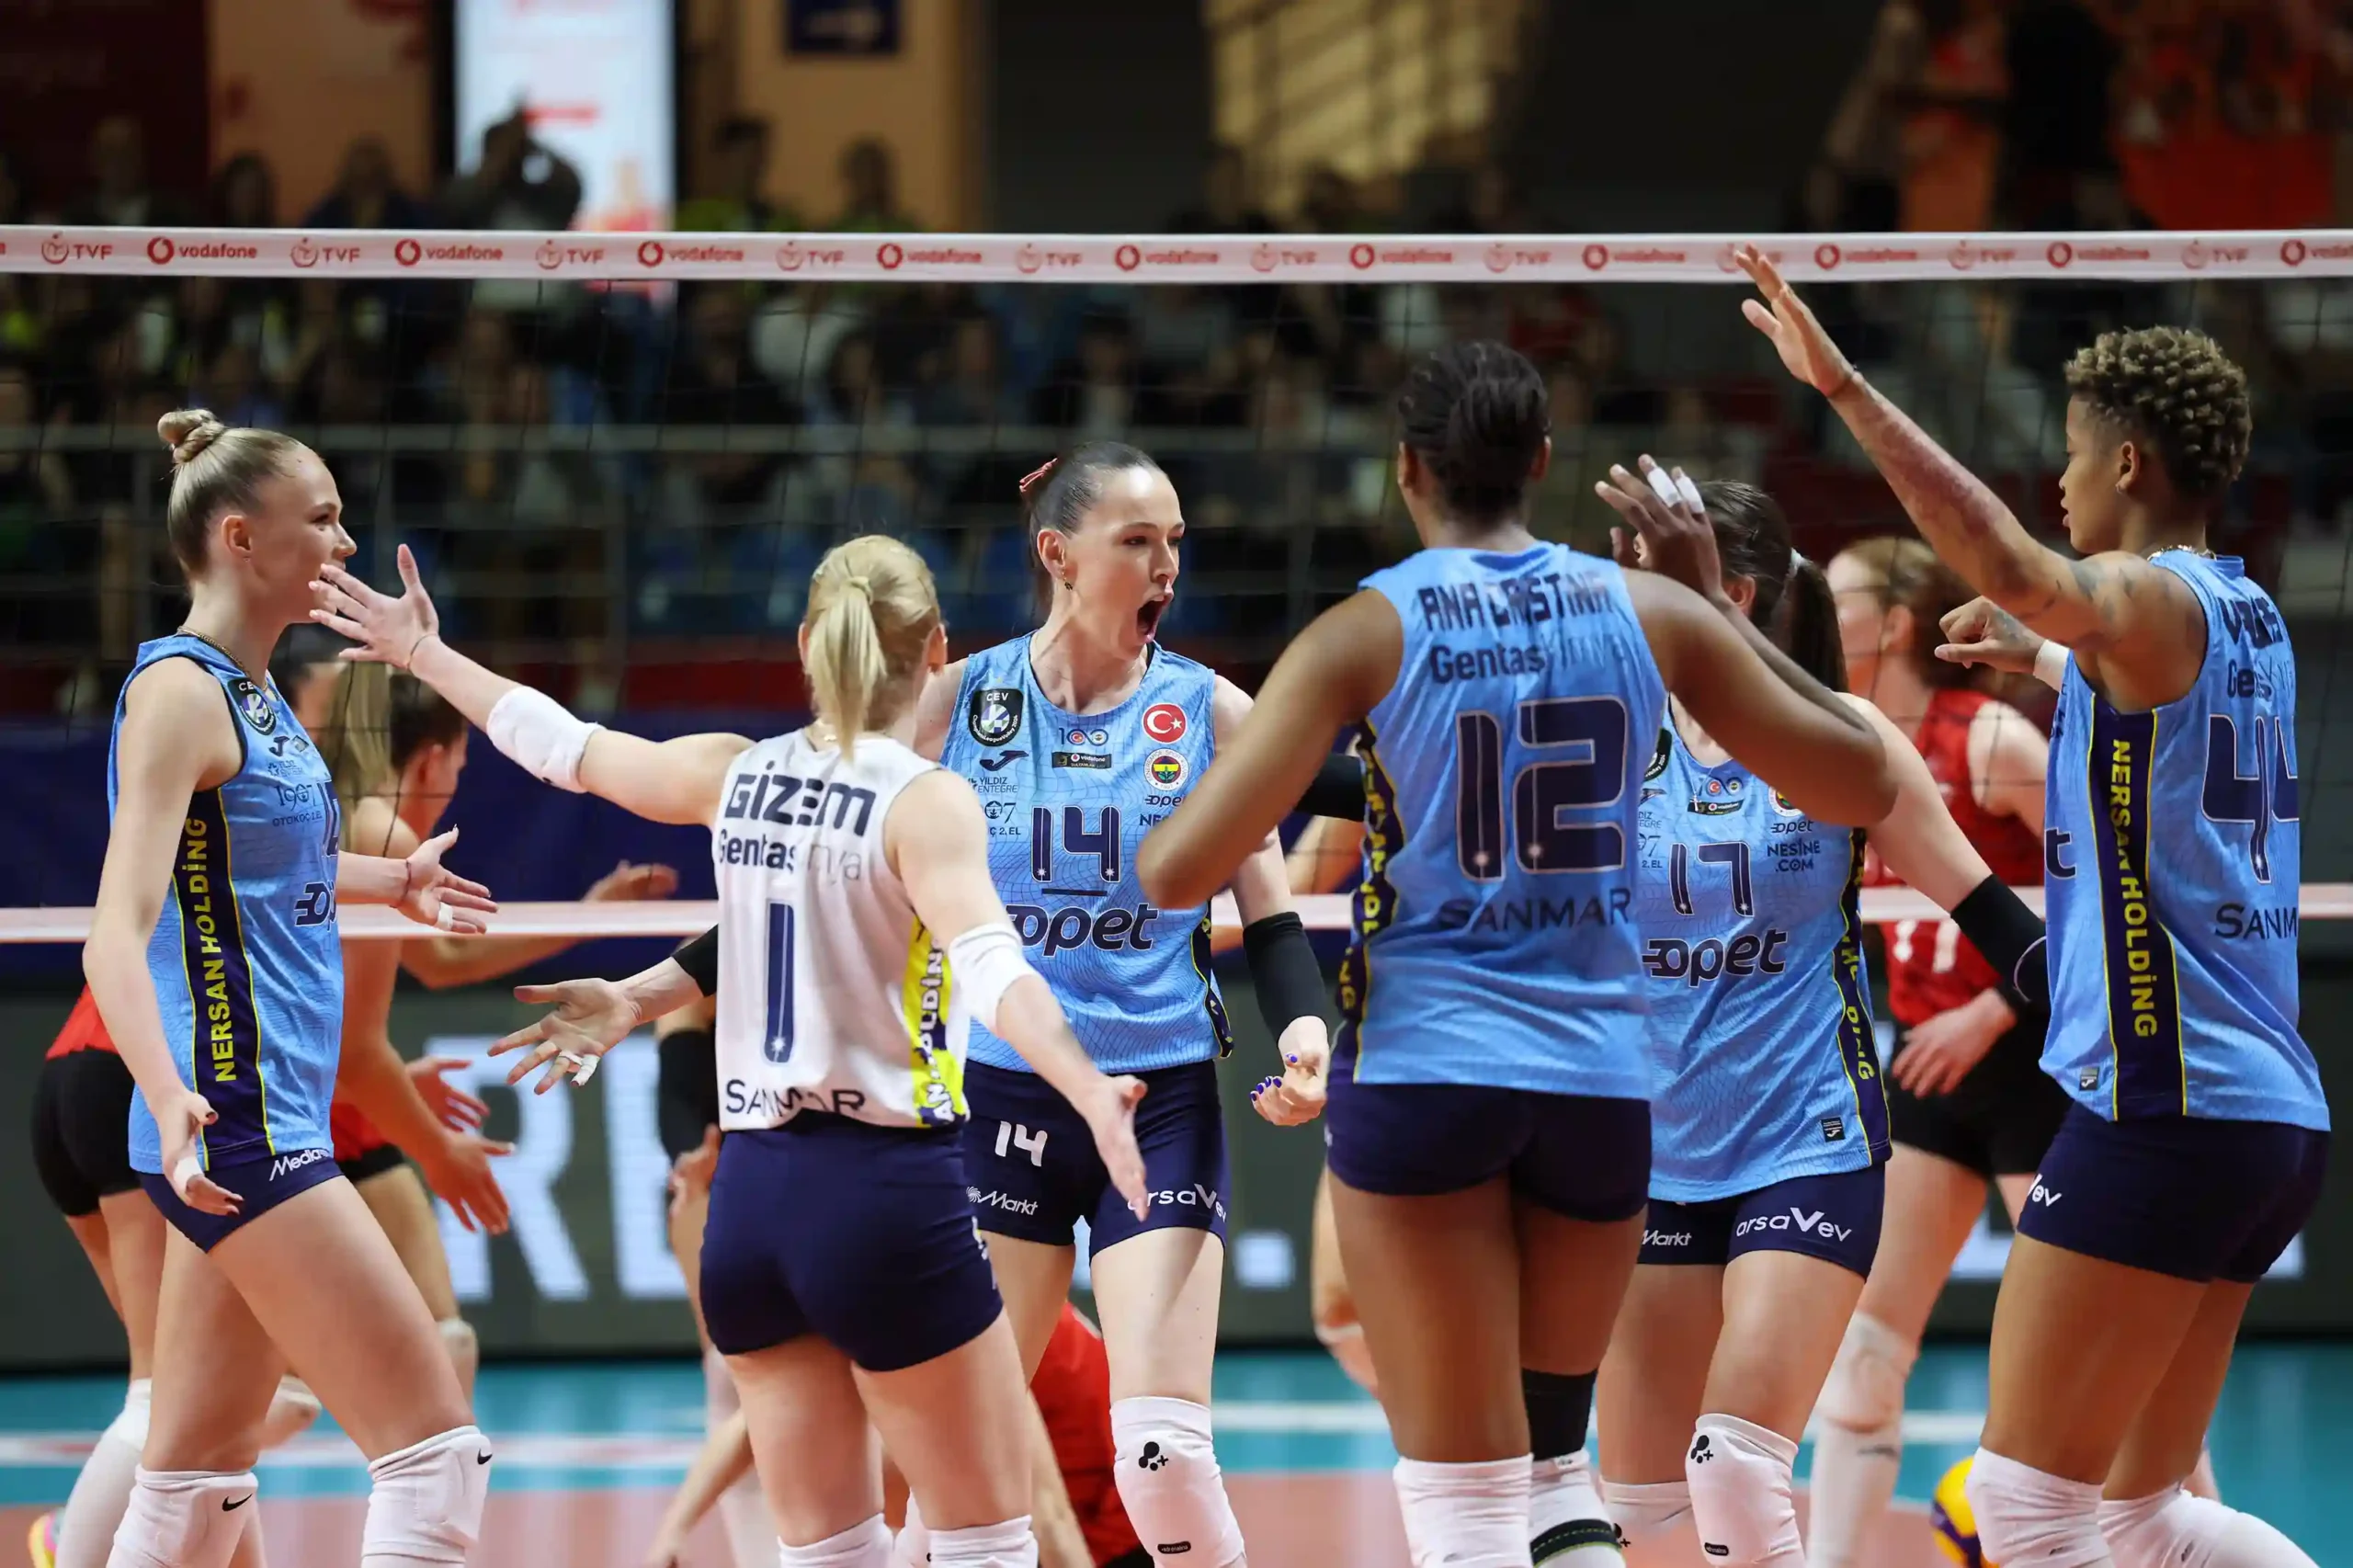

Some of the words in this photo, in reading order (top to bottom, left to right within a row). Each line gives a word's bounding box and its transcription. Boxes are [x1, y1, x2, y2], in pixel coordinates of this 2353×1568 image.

[72, 244, 113, 260] TVF
[178, 244, 258, 259] vodafone
[322, 246, 361, 264] TVF
[426, 245, 504, 261] vodafone
[566, 248, 605, 265] TVF
[667, 246, 745, 262] vodafone
[1417, 583, 1483, 632] ANA
[986, 692, 1009, 701] CEV
[978, 785, 1017, 793] ENTEGRE
[980, 777, 1007, 785] YILDIZ
[1455, 694, 1630, 883] 12
[1031, 805, 1121, 883] 14
[1775, 858, 1814, 873] .COM
[1668, 841, 1755, 917] 17
[1438, 887, 1631, 933] SANMAR
[1006, 903, 1160, 958] opet
[1642, 928, 1789, 989] opet
[763, 901, 796, 1063] 1
[202, 959, 236, 1082] NERSAN
[995, 1120, 1048, 1166] 14
[983, 1190, 1038, 1216] Markt
[1642, 1229, 1692, 1246] Markt
